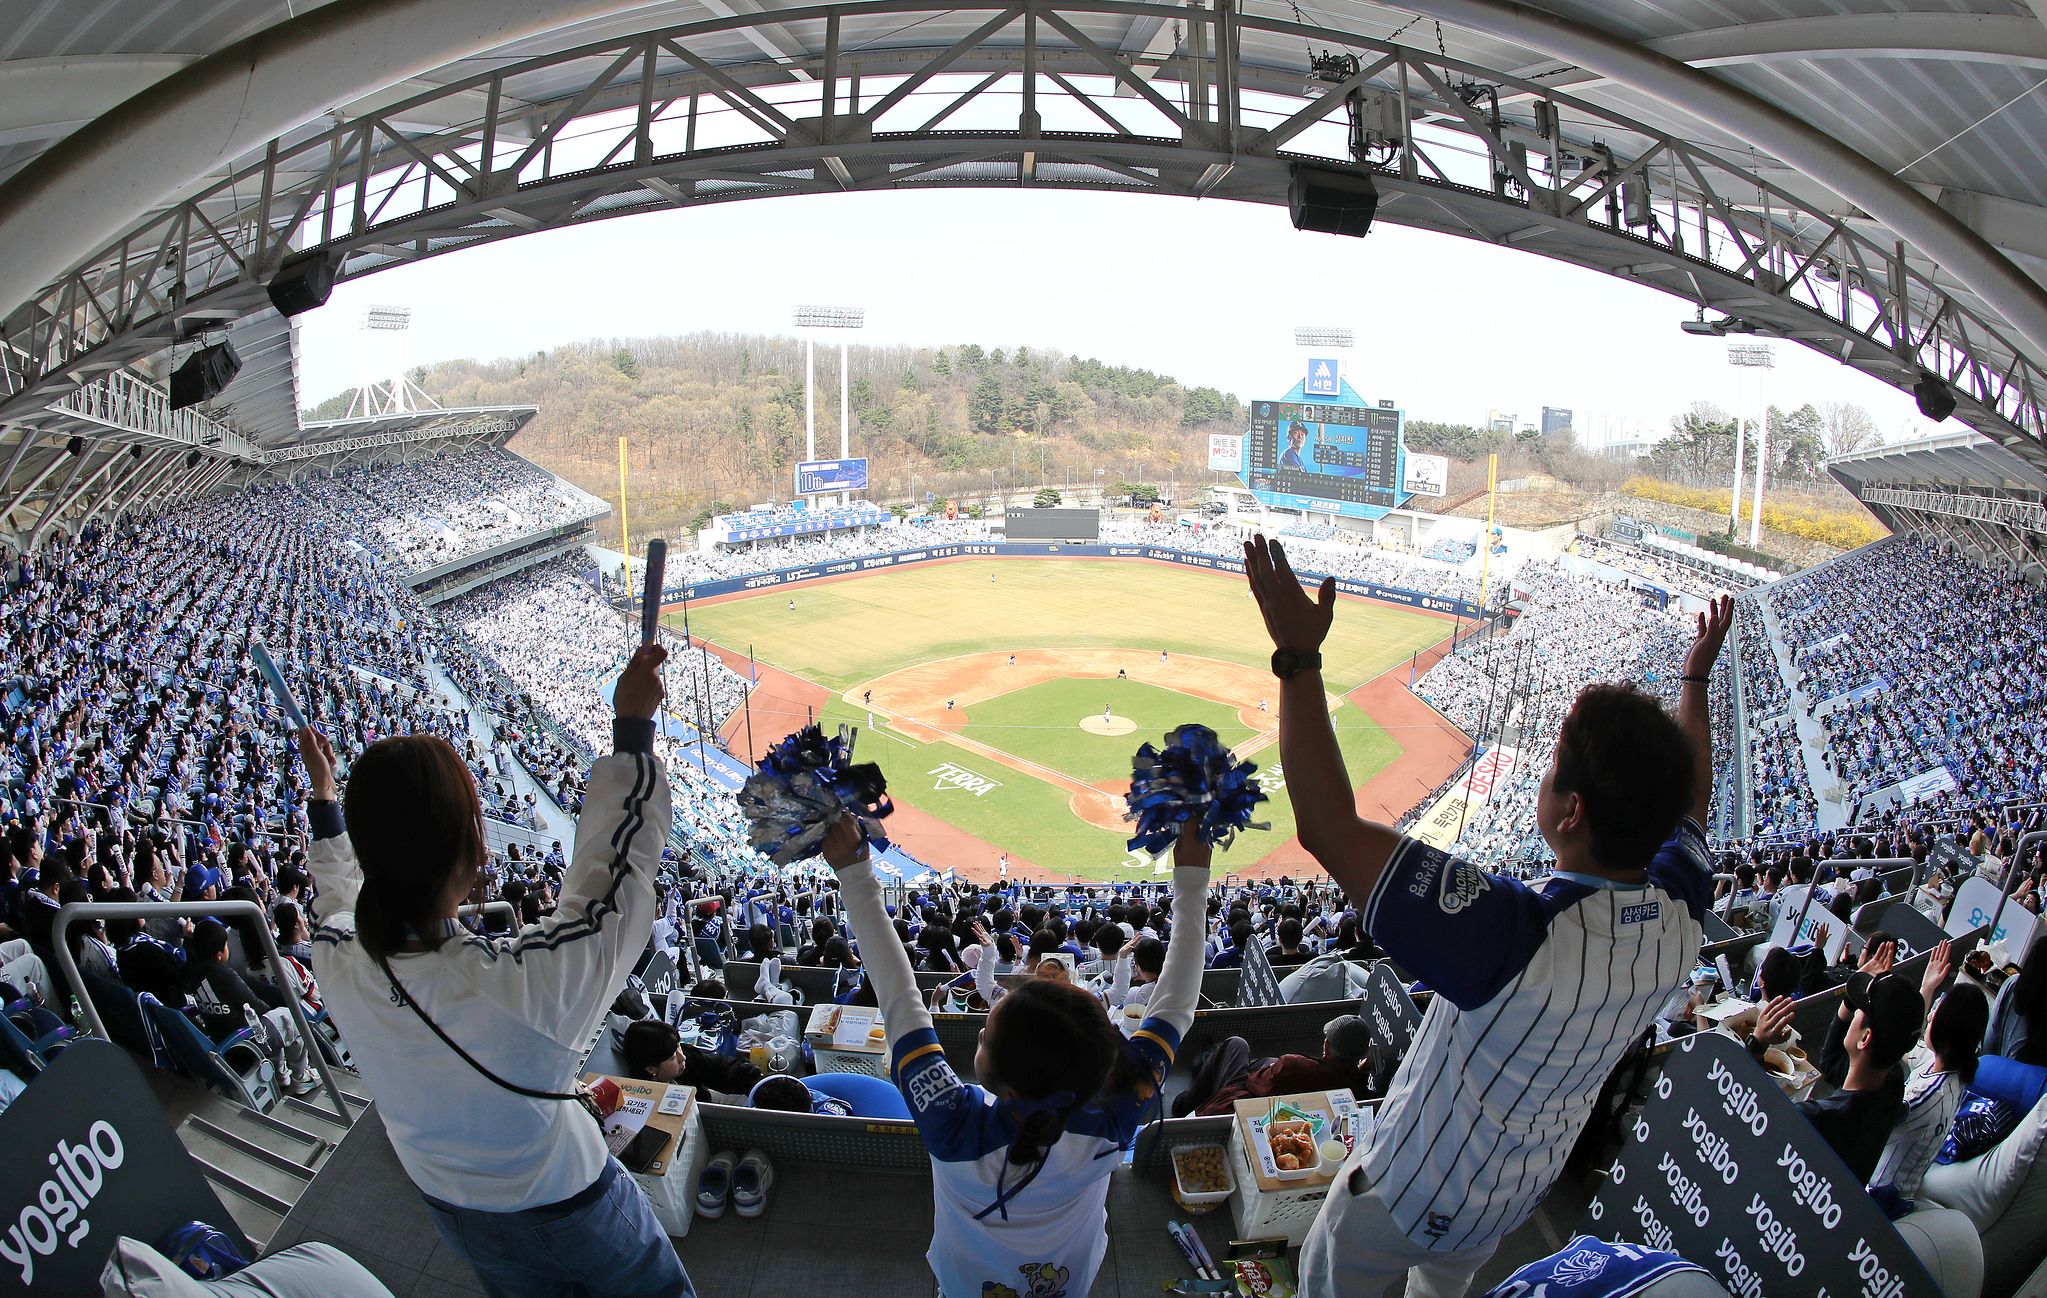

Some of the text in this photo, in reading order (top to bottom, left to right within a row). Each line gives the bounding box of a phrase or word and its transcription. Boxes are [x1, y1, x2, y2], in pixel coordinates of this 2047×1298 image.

[1312, 380, 1332, 391] 서한
[1213, 438, 1237, 448] 메트로
[964, 546, 996, 554] 대방건설
[928, 762, 996, 798] TERRA
[1623, 904, 1658, 924] 삼성카드
[1380, 976, 1402, 1018] yogibo
[1372, 1004, 1394, 1046] yogibo
[1706, 1058, 1768, 1136] yogibo
[1682, 1106, 1739, 1184] yogibo
[0, 1120, 125, 1287] yogibo
[1658, 1152, 1710, 1228] yogibo
[1776, 1143, 1843, 1230] yogibo
[1746, 1192, 1806, 1277] yogibo
